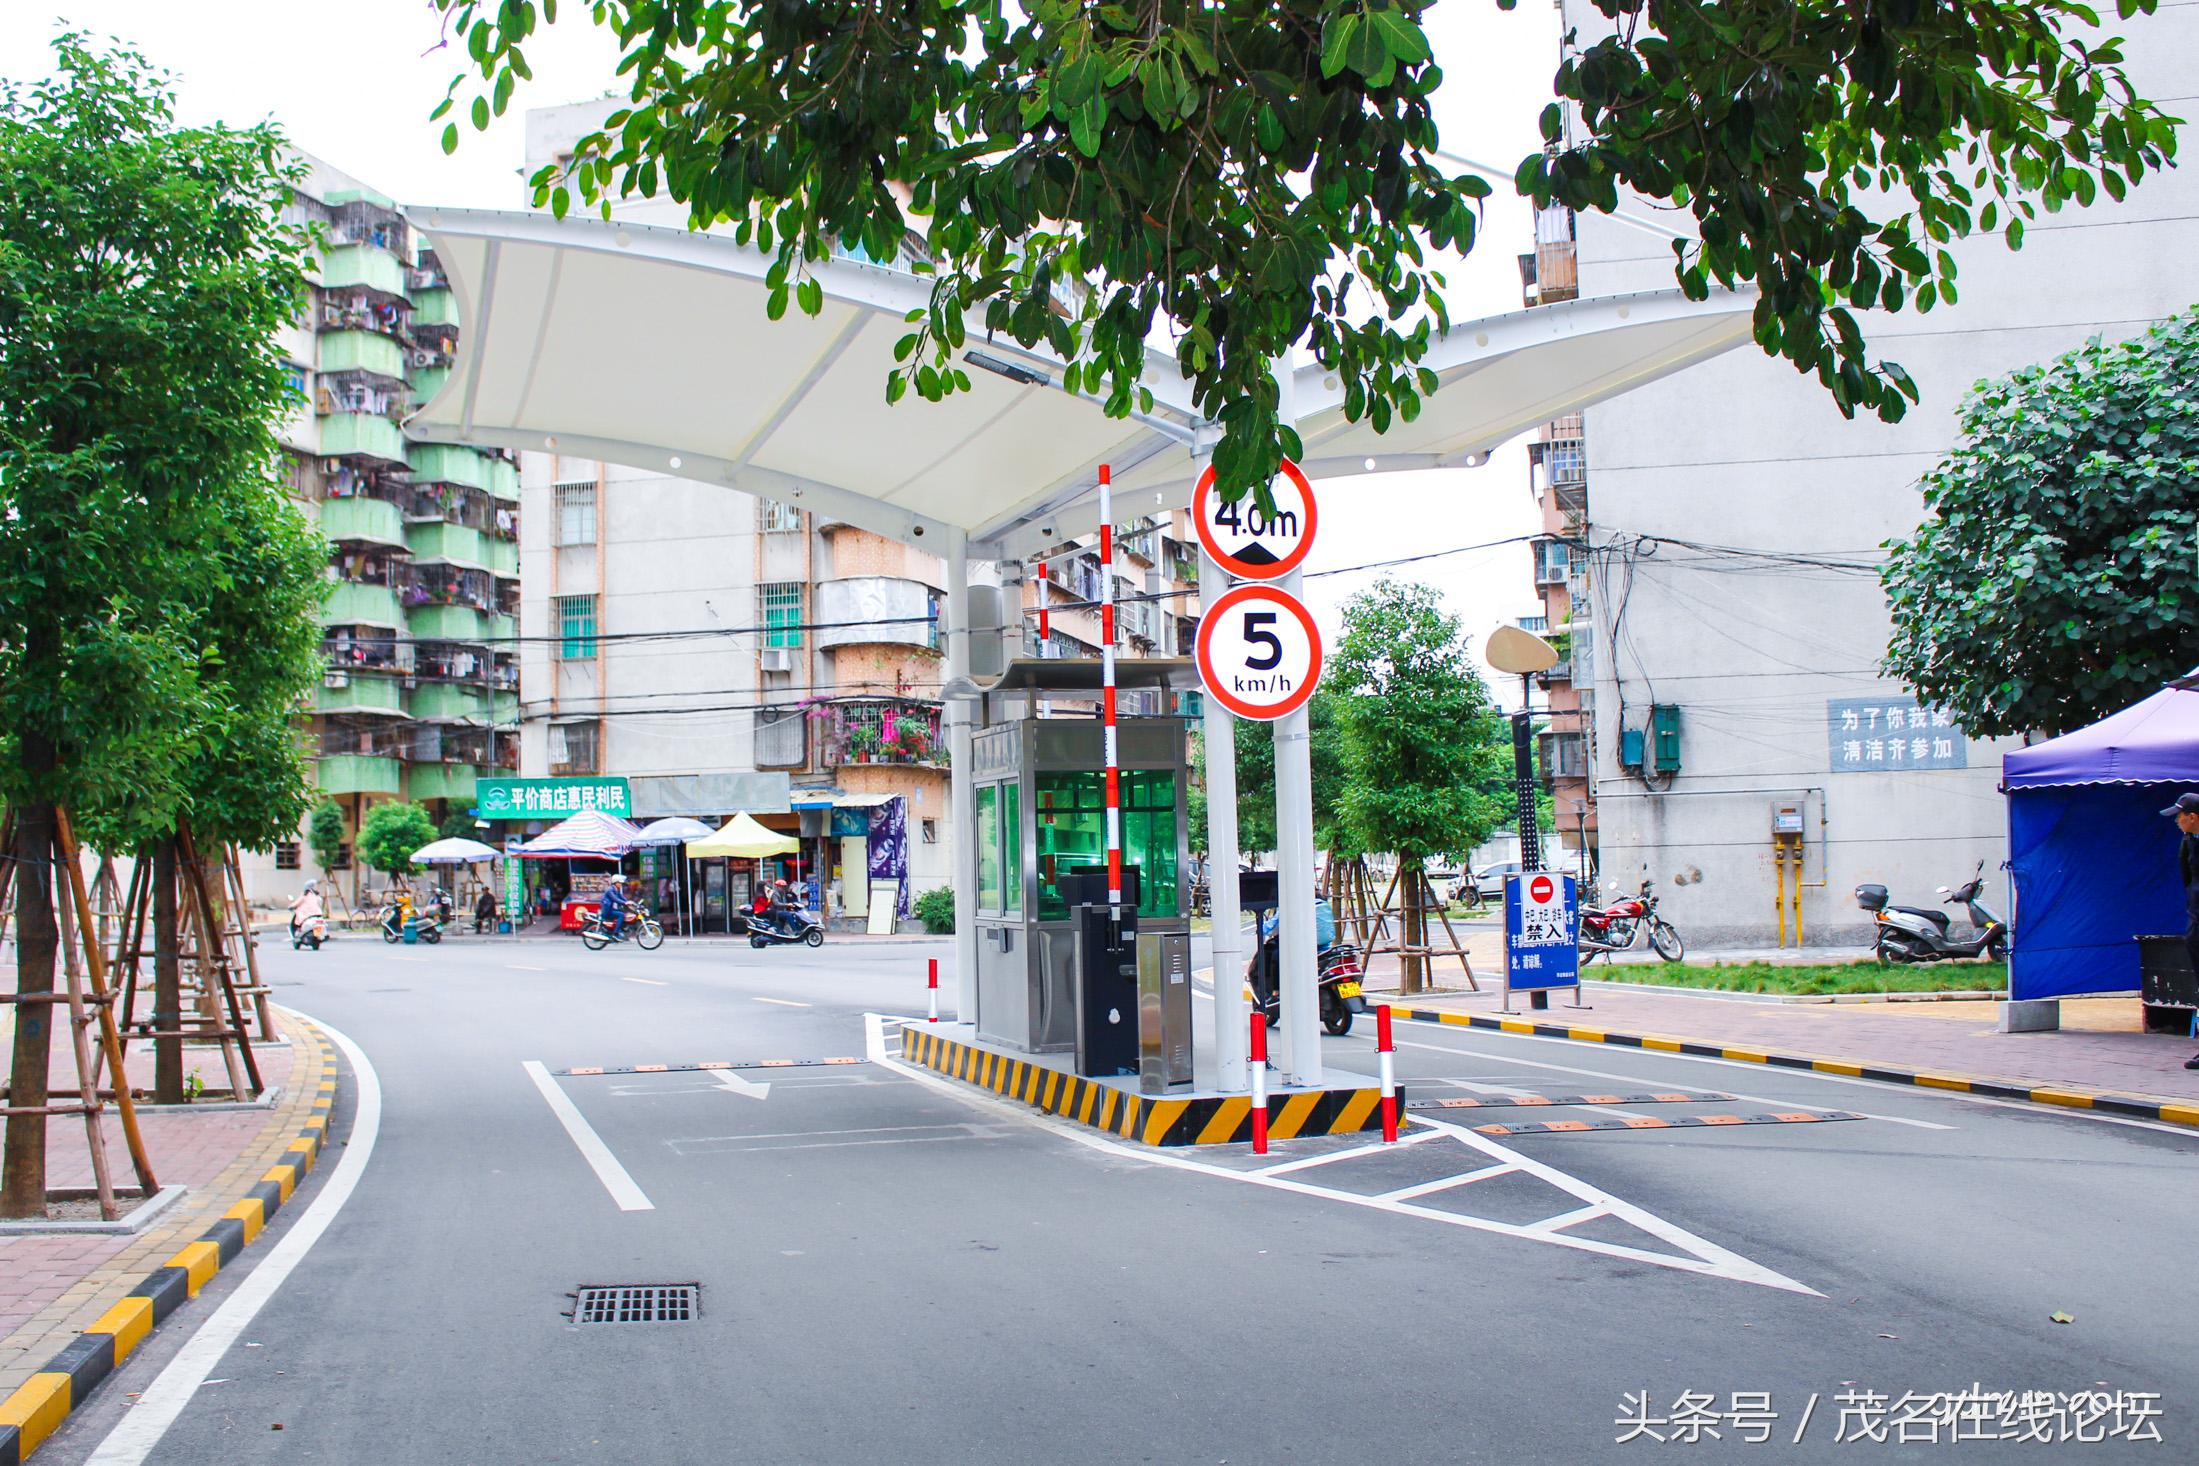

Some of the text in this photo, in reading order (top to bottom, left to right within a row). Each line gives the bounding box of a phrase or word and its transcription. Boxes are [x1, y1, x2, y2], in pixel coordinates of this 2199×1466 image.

[1243, 612, 1283, 671] 5
[1234, 674, 1292, 694] km/h
[1843, 736, 1952, 761] 清洁齐参加
[511, 786, 625, 810] 平价商店惠民利民
[1526, 923, 1562, 941] 禁入
